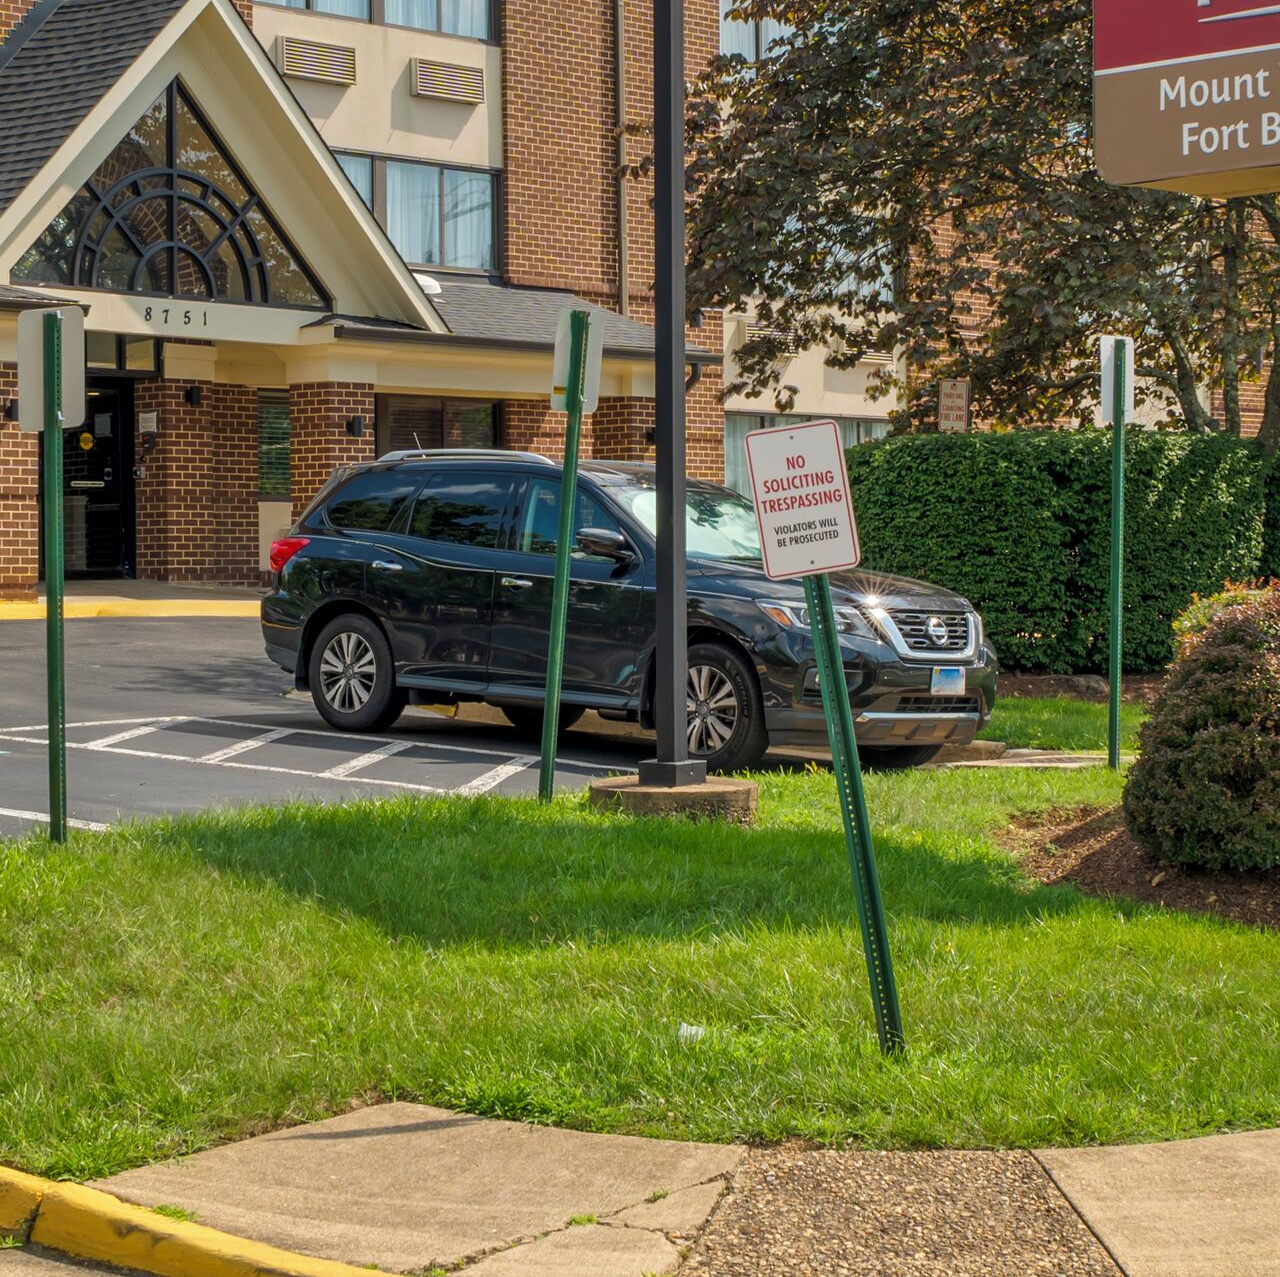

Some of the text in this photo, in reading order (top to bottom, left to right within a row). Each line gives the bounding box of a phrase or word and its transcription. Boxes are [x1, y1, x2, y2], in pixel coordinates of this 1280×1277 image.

[1158, 68, 1270, 112] Mount
[1182, 120, 1250, 156] Fort
[786, 455, 806, 471] NO
[763, 470, 834, 494] SOLICITING
[761, 489, 842, 514] TRESPASSING
[774, 517, 838, 535] VIOLATORS WILL
[777, 529, 839, 548] BE PROSECUTED
